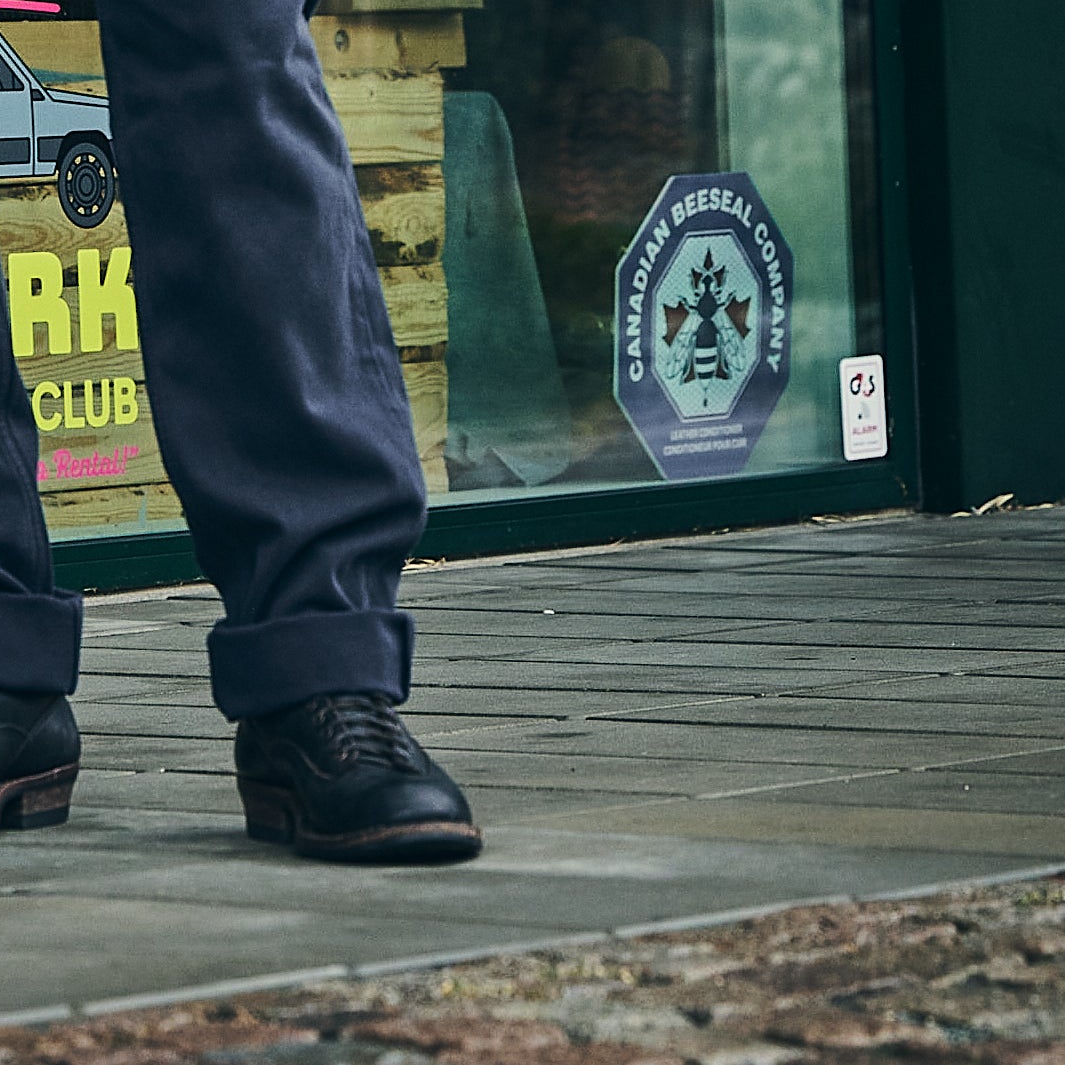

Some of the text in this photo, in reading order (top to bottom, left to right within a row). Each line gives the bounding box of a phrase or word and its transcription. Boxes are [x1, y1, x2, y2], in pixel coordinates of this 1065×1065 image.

[626, 187, 786, 383] CANADIAN BEESEAL COMPANY
[31, 377, 139, 431] CLUB
